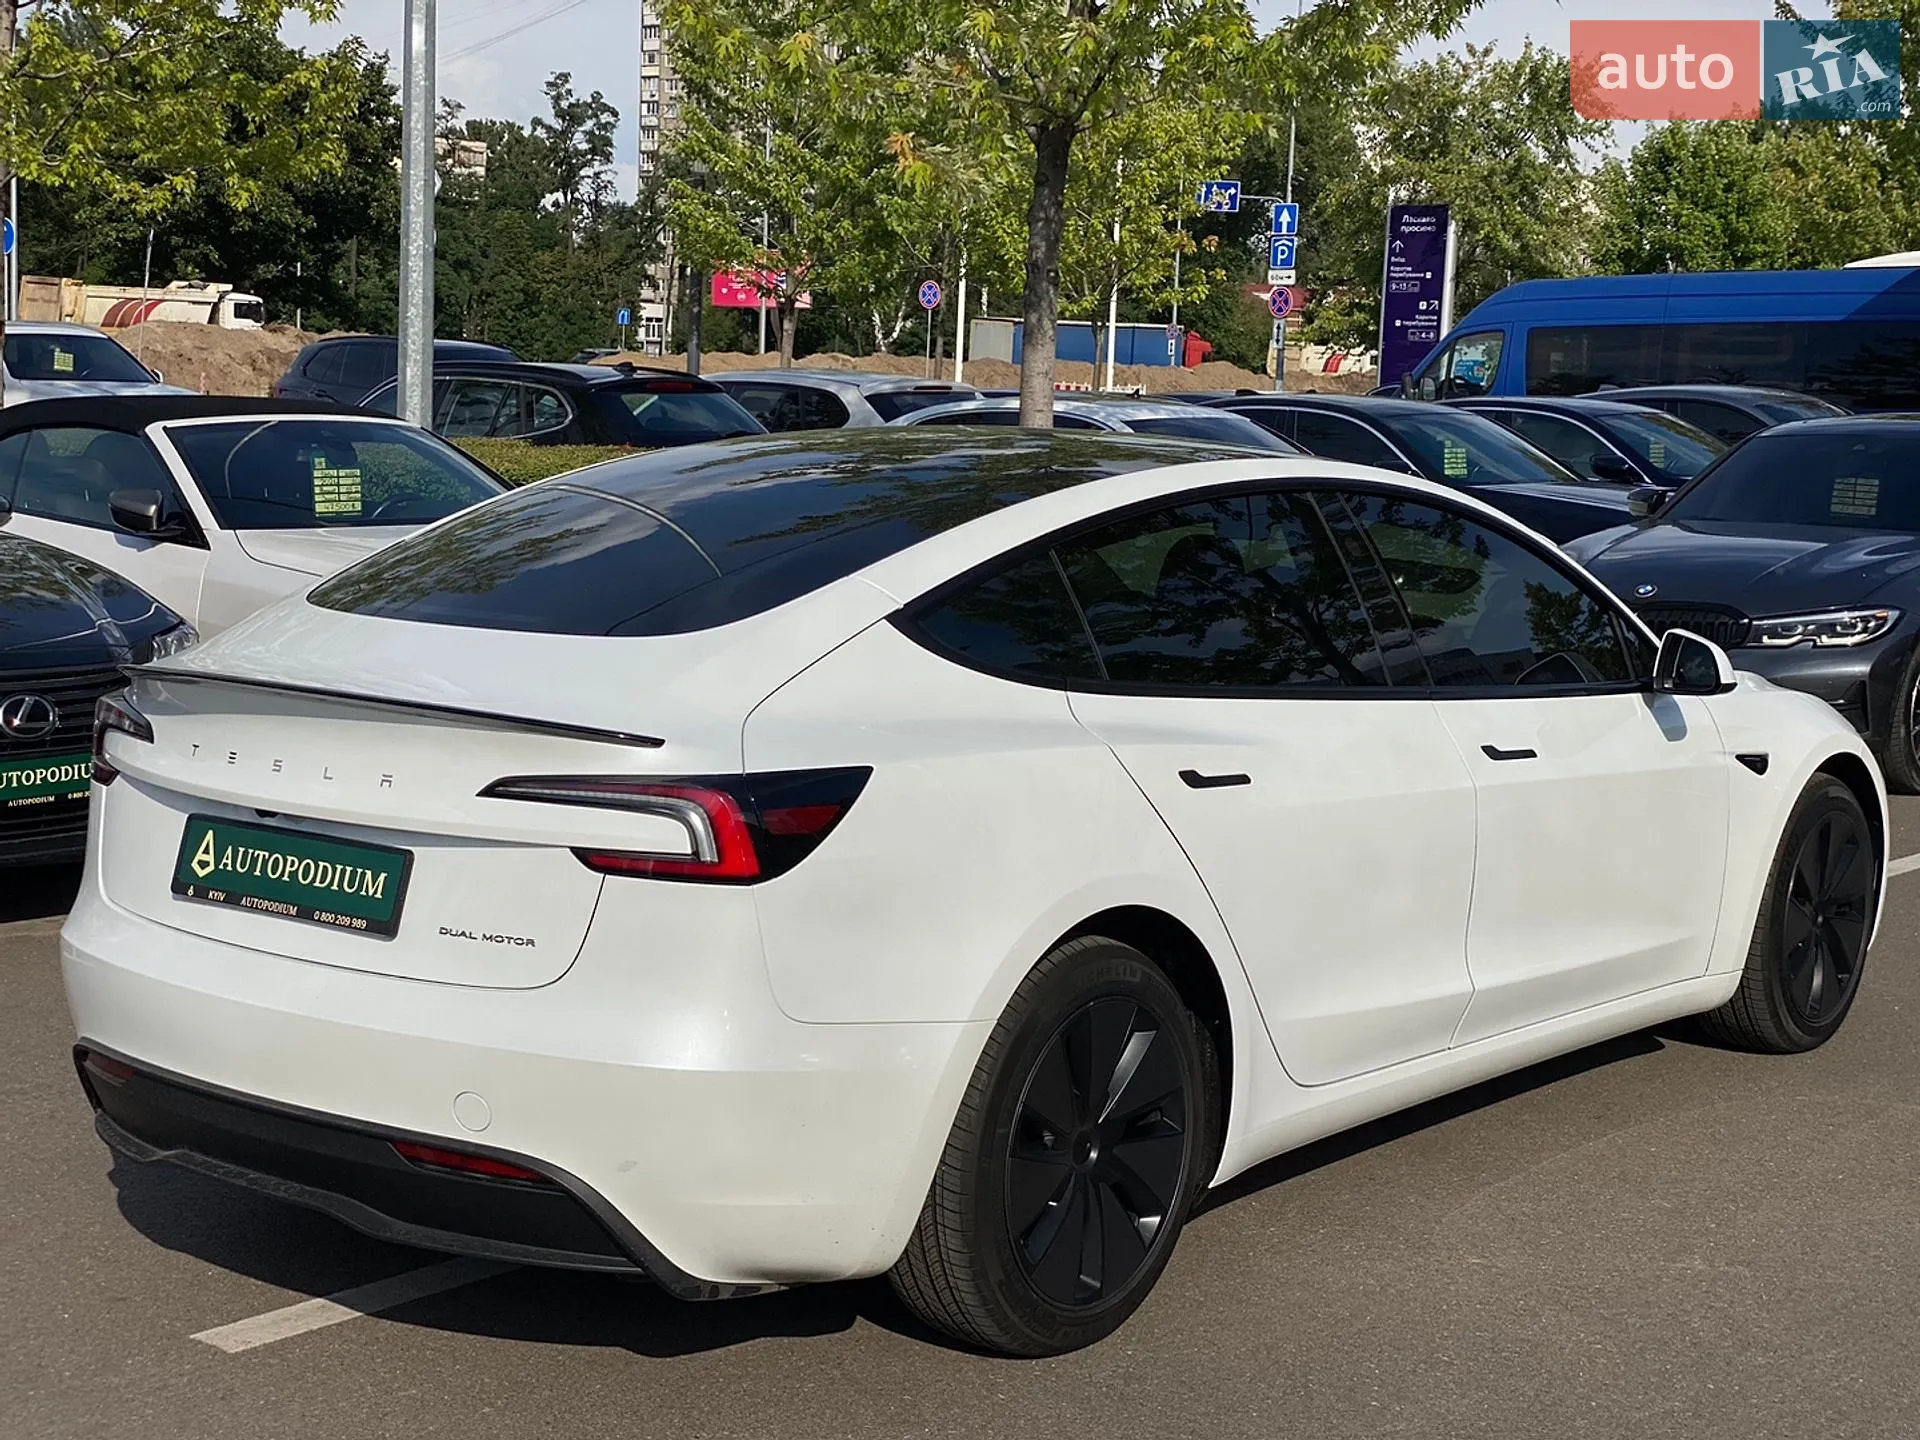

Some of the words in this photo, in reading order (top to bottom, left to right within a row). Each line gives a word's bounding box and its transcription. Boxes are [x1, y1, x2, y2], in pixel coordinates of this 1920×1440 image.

[192, 743, 393, 788] TESLA
[8, 795, 55, 807] AUTOPODIUM
[218, 845, 388, 899] AUTOPODIUM
[208, 890, 226, 901] KYIV
[240, 896, 298, 916] AUTOPODIUM
[313, 910, 320, 920] 0
[320, 912, 335, 923] 800
[335, 915, 350, 926] 209
[351, 917, 367, 929] 989
[439, 926, 478, 940] DUAL
[481, 933, 536, 948] MOTOR
